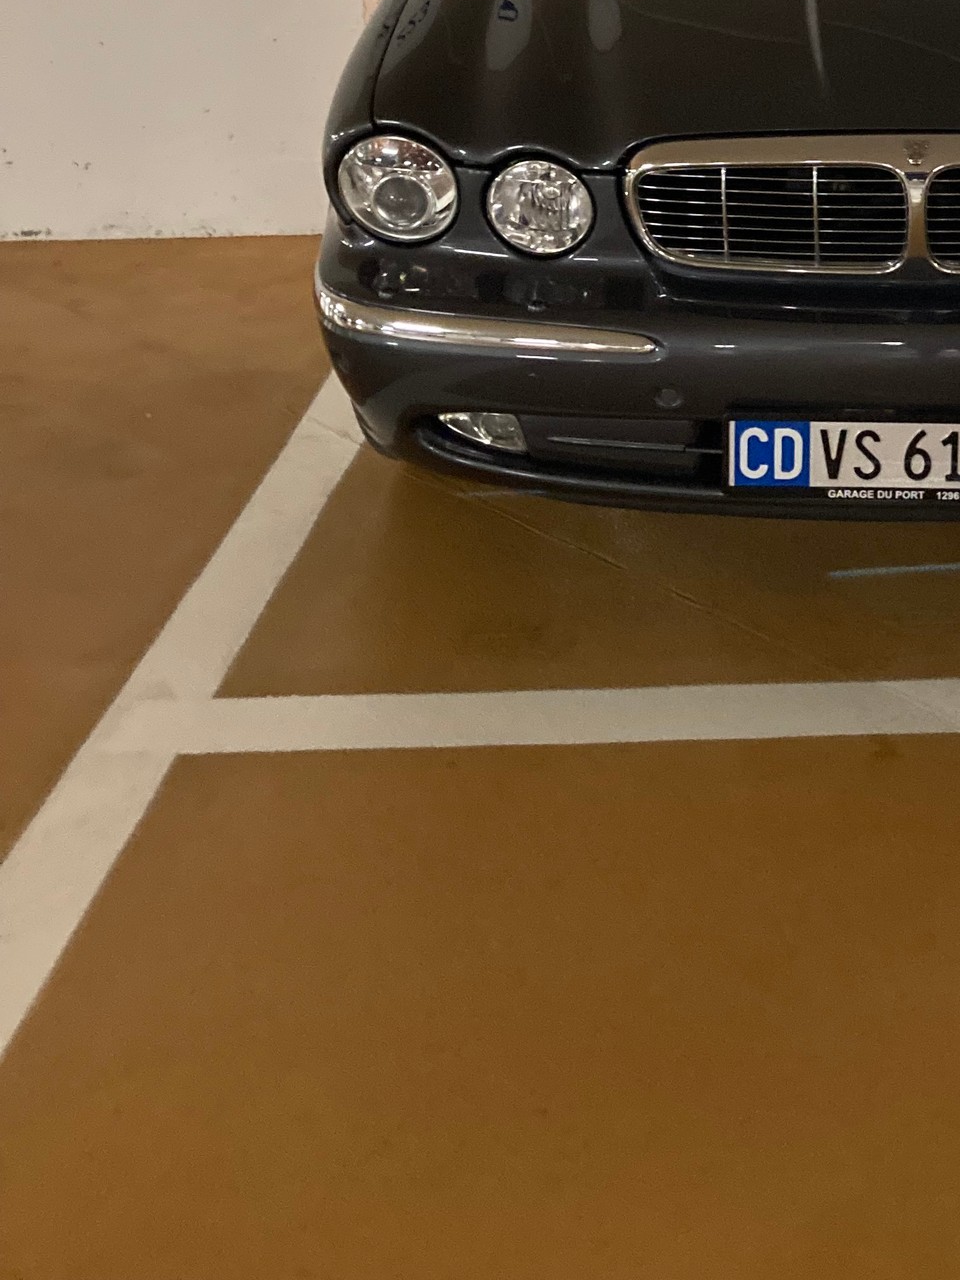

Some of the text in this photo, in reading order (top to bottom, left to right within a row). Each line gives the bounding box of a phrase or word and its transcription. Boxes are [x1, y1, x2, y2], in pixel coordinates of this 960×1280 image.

[739, 427, 804, 480] CD
[820, 429, 882, 480] VS
[827, 489, 875, 499] GARAGE
[877, 489, 893, 499] DU
[895, 490, 925, 500] PORT
[936, 491, 960, 500] 1296
